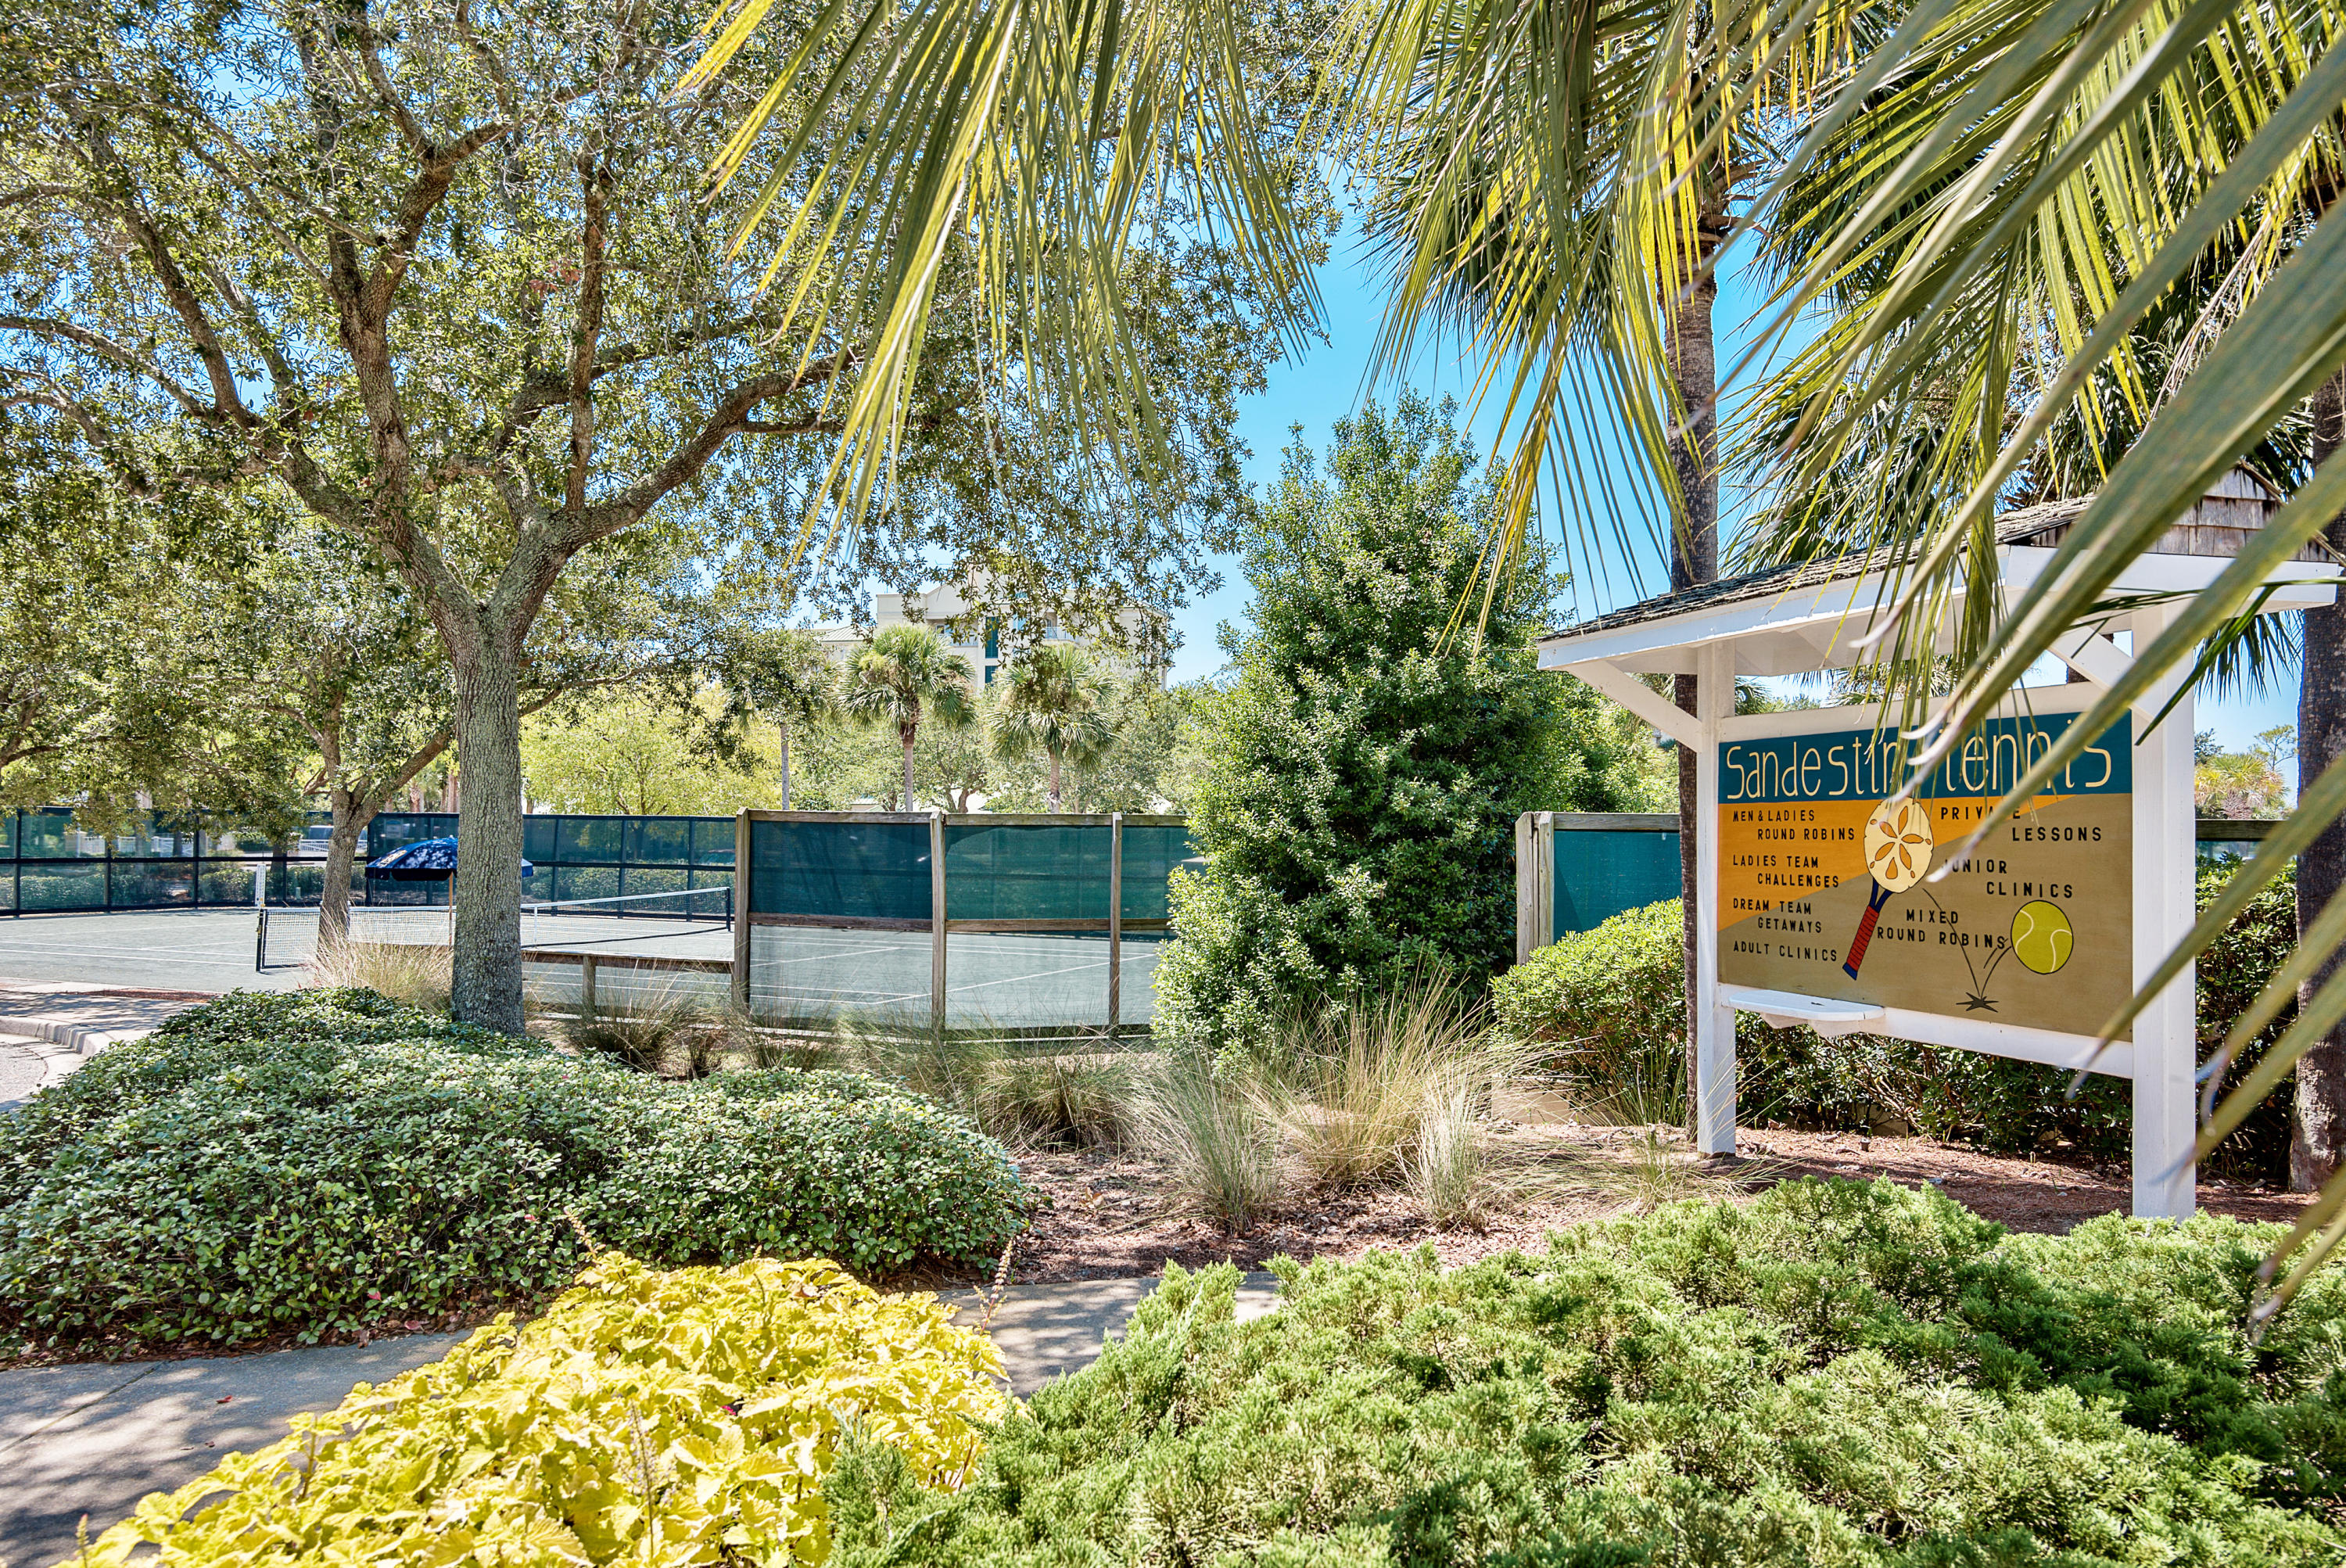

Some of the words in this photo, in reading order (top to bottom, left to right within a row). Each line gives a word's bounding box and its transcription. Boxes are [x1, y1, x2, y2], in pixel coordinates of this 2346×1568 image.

[1940, 806, 2021, 820] PRIVE
[1757, 828, 1795, 841] ROUND
[1803, 827, 1855, 841] ROBINS
[2011, 826, 2102, 842] LESSONS
[1733, 855, 1777, 867] LADIES
[1786, 856, 1818, 868] TEAM
[1941, 858, 2007, 874] UNIOR
[1757, 873, 1839, 888] CHALLENGES
[1986, 881, 2073, 899] CLINICS
[1733, 898, 1770, 912] DREAM
[1779, 900, 1812, 915] TEAM
[1906, 908, 1959, 924] MIXED
[1757, 916, 1822, 934] GETAWAYS
[1877, 926, 1926, 942] ROUND
[1939, 931, 2005, 950] ROBINS
[1733, 940, 1770, 955] ADULT
[1779, 945, 1837, 962] CLINICS
